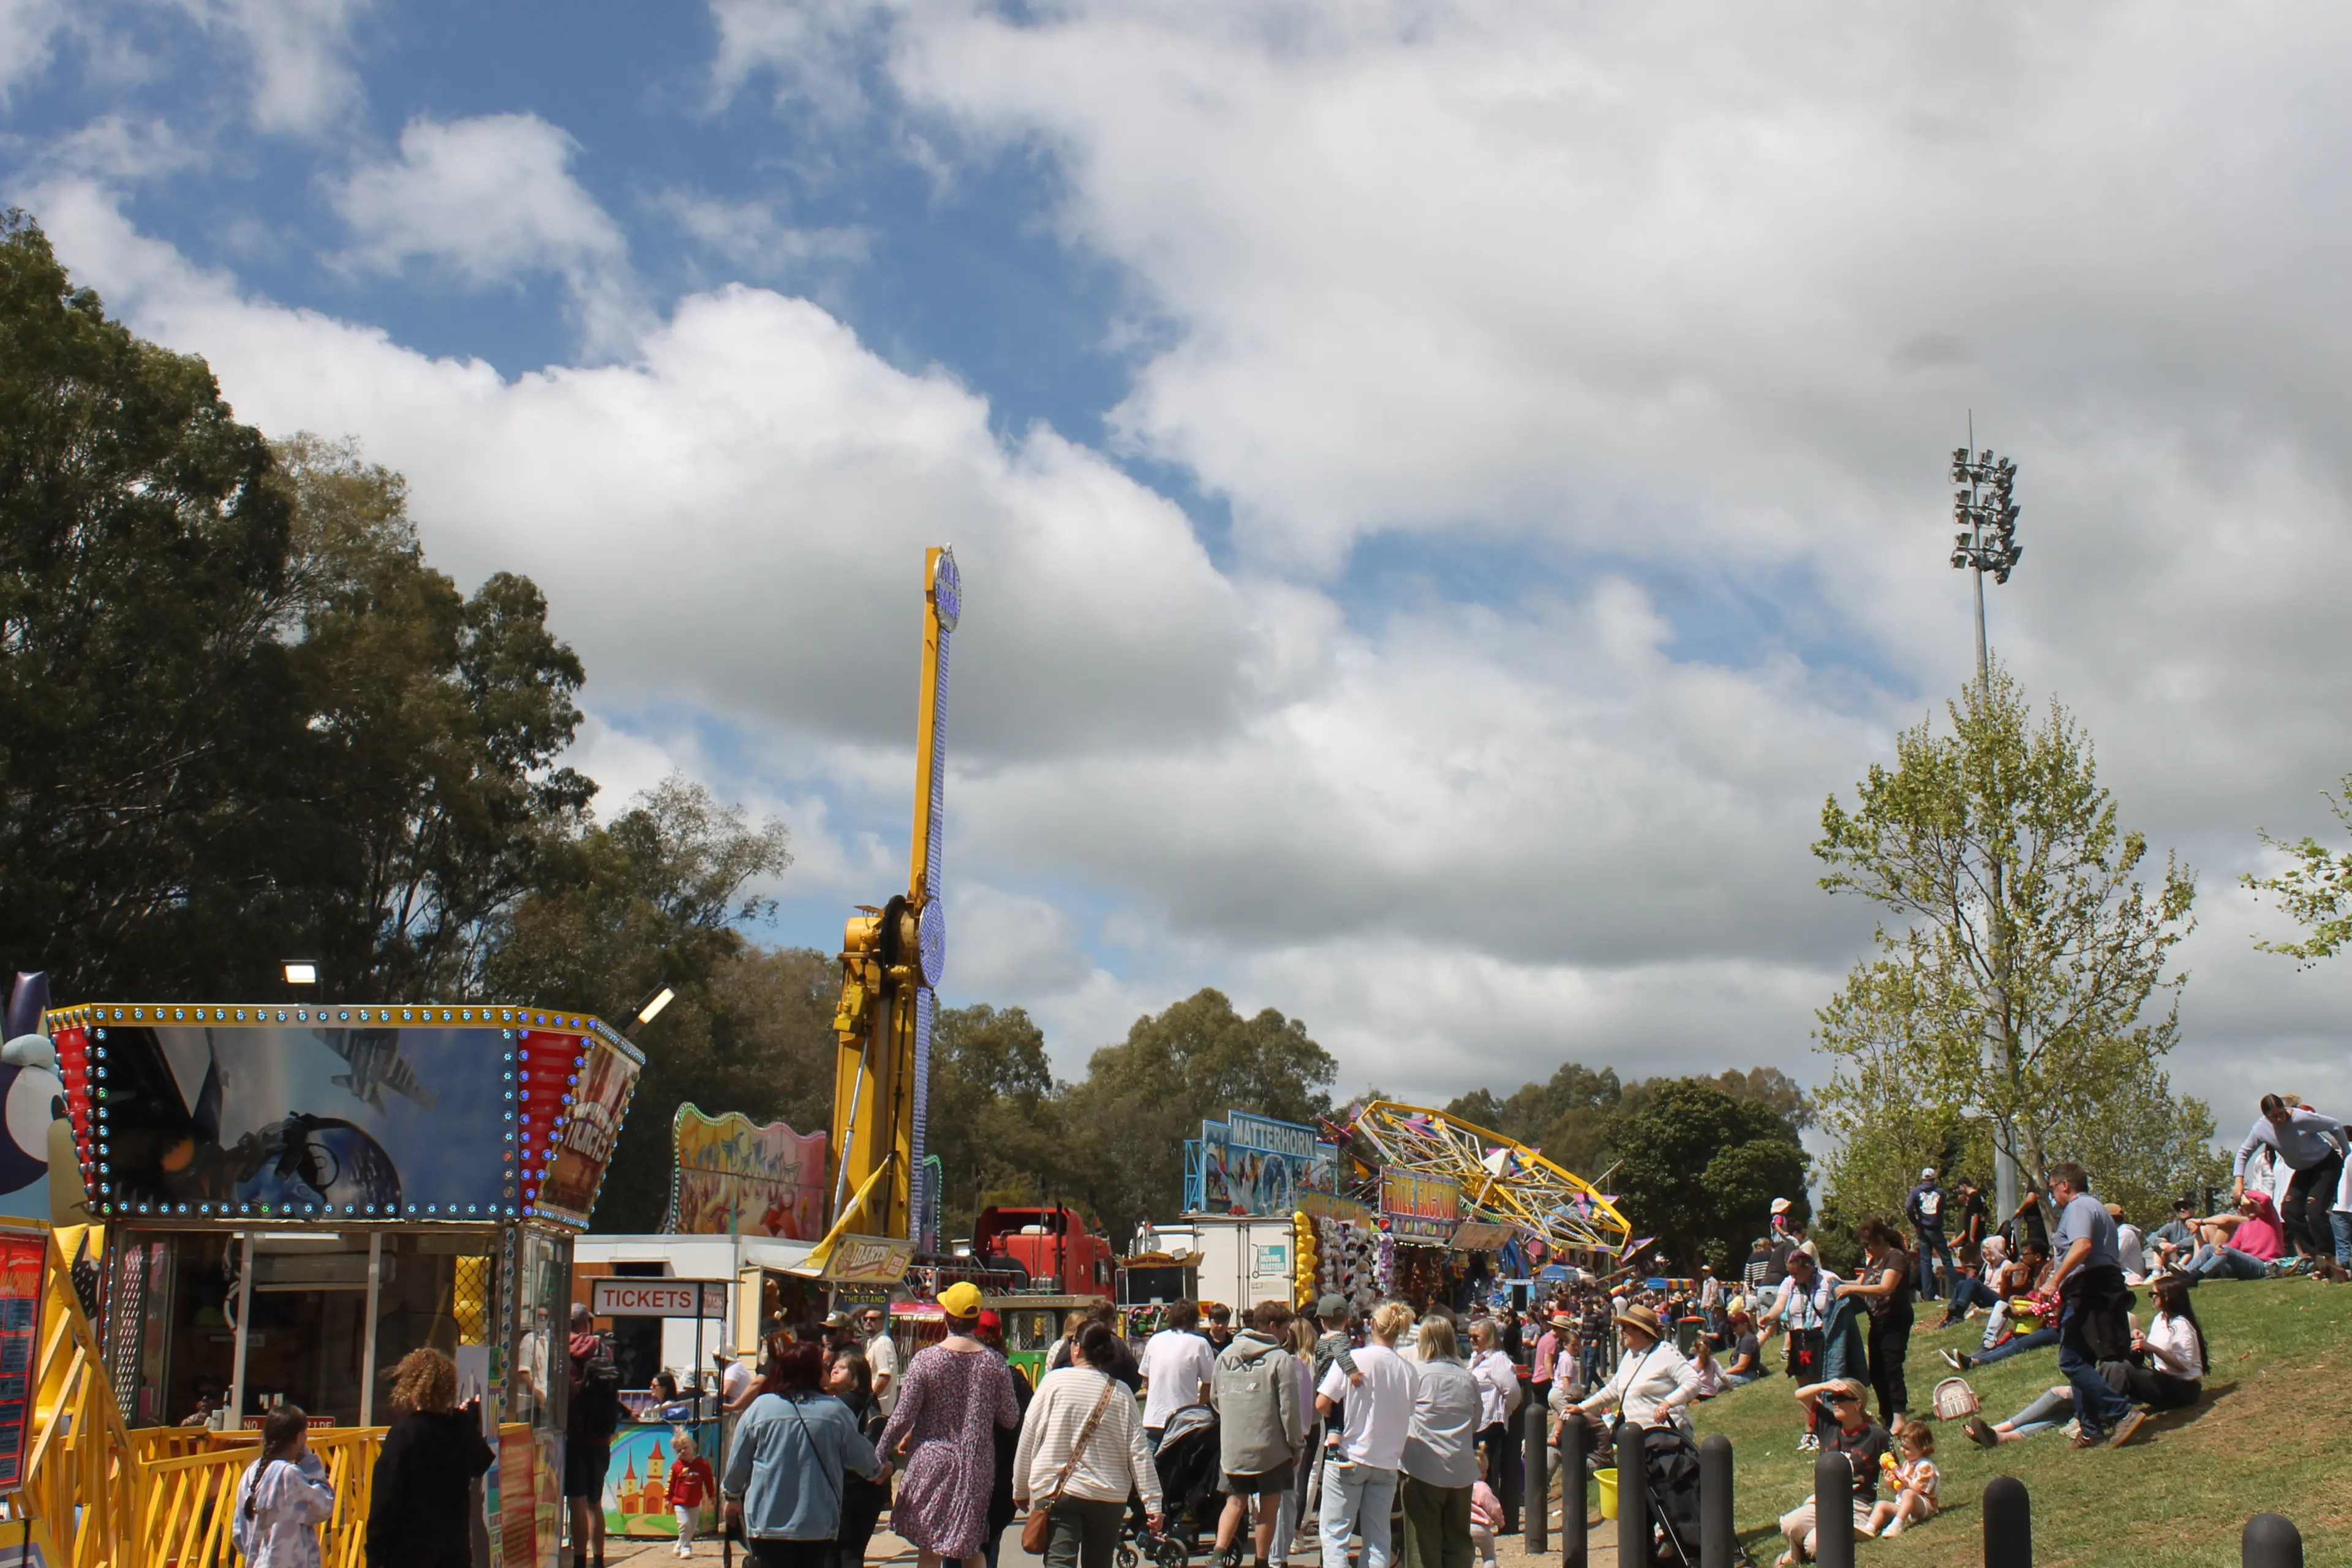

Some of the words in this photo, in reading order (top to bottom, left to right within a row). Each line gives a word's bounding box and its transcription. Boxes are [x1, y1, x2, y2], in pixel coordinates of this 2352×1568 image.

[1232, 1118, 1313, 1156] MATTERHORN
[850, 1243, 891, 1267] DARTS
[1261, 1262, 1285, 1271] MASTERS
[603, 1289, 692, 1308] TICKETS
[1219, 1355, 1267, 1373] NXP
